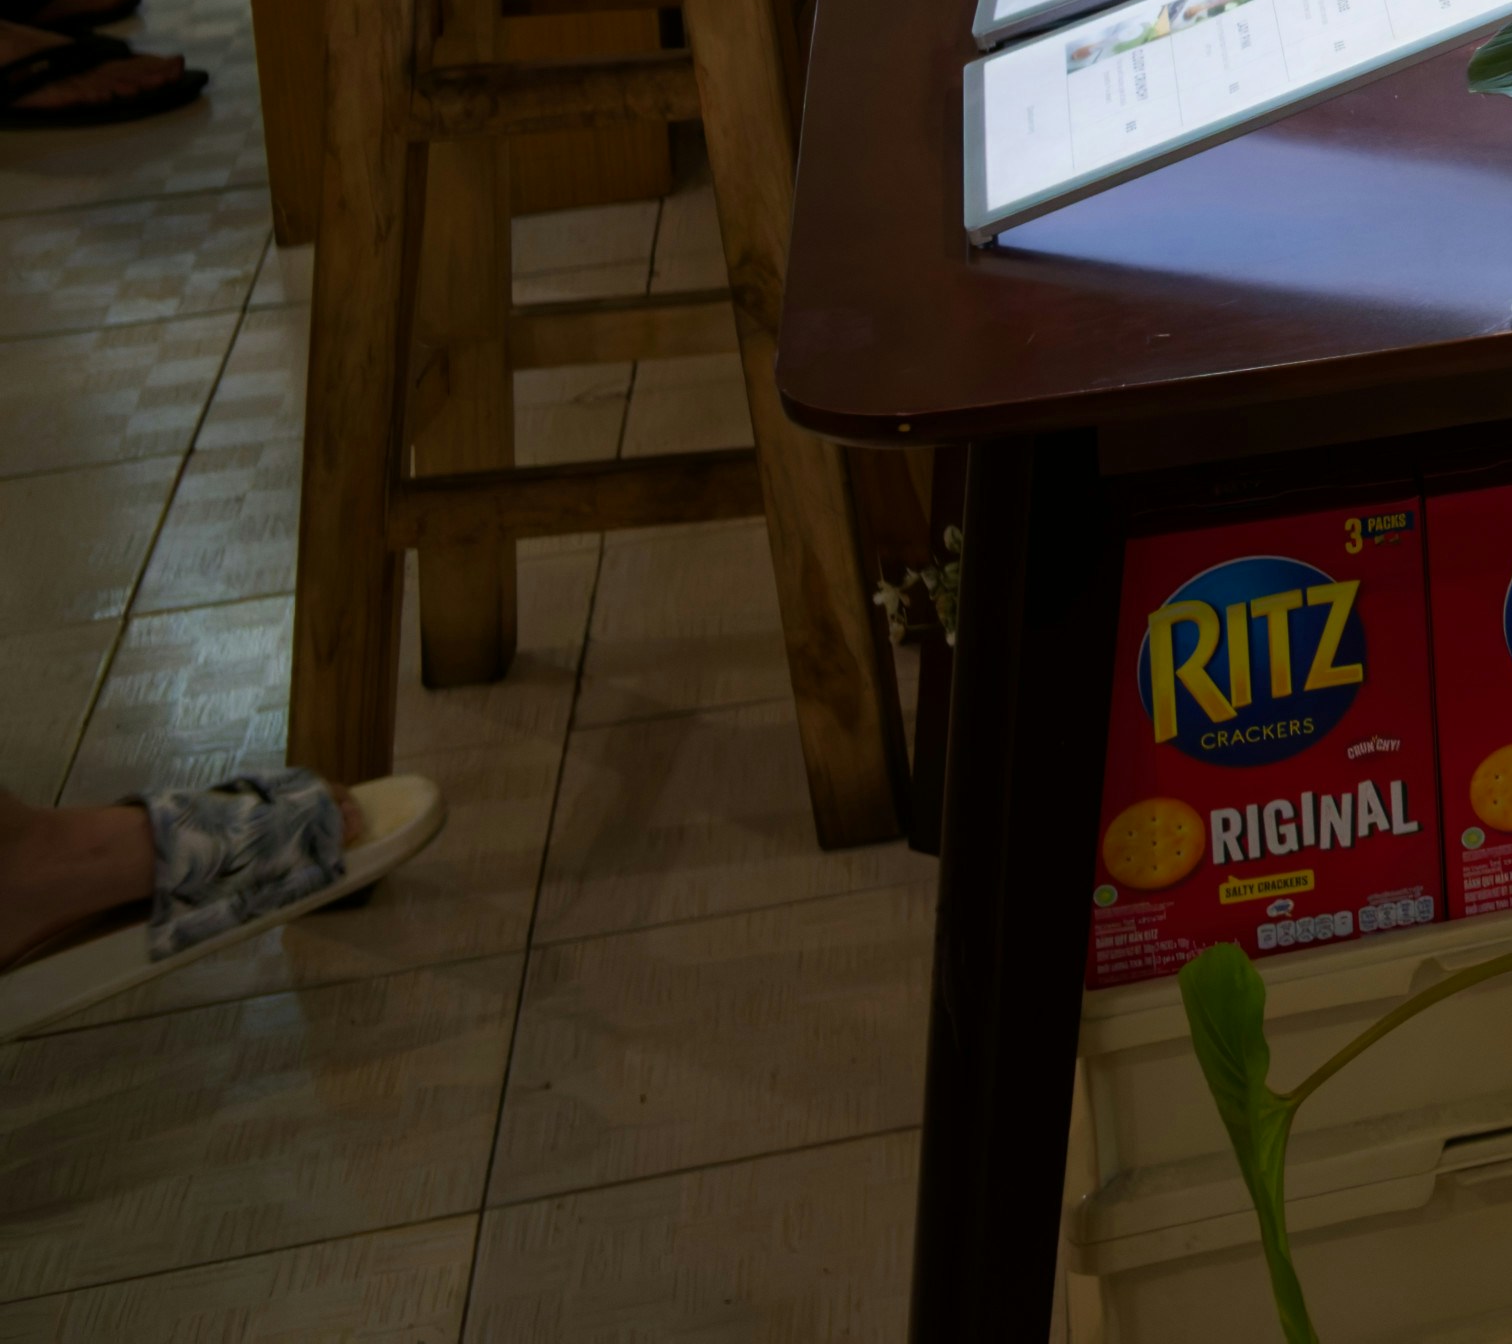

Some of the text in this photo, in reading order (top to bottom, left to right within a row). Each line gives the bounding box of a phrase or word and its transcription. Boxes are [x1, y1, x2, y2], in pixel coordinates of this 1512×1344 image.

[1344, 513, 1407, 554] 3 PACKS
[1147, 579, 1364, 744] RITZ
[1201, 718, 1315, 751] CRACKERS
[1225, 874, 1309, 898] SALTY CRACKERS
